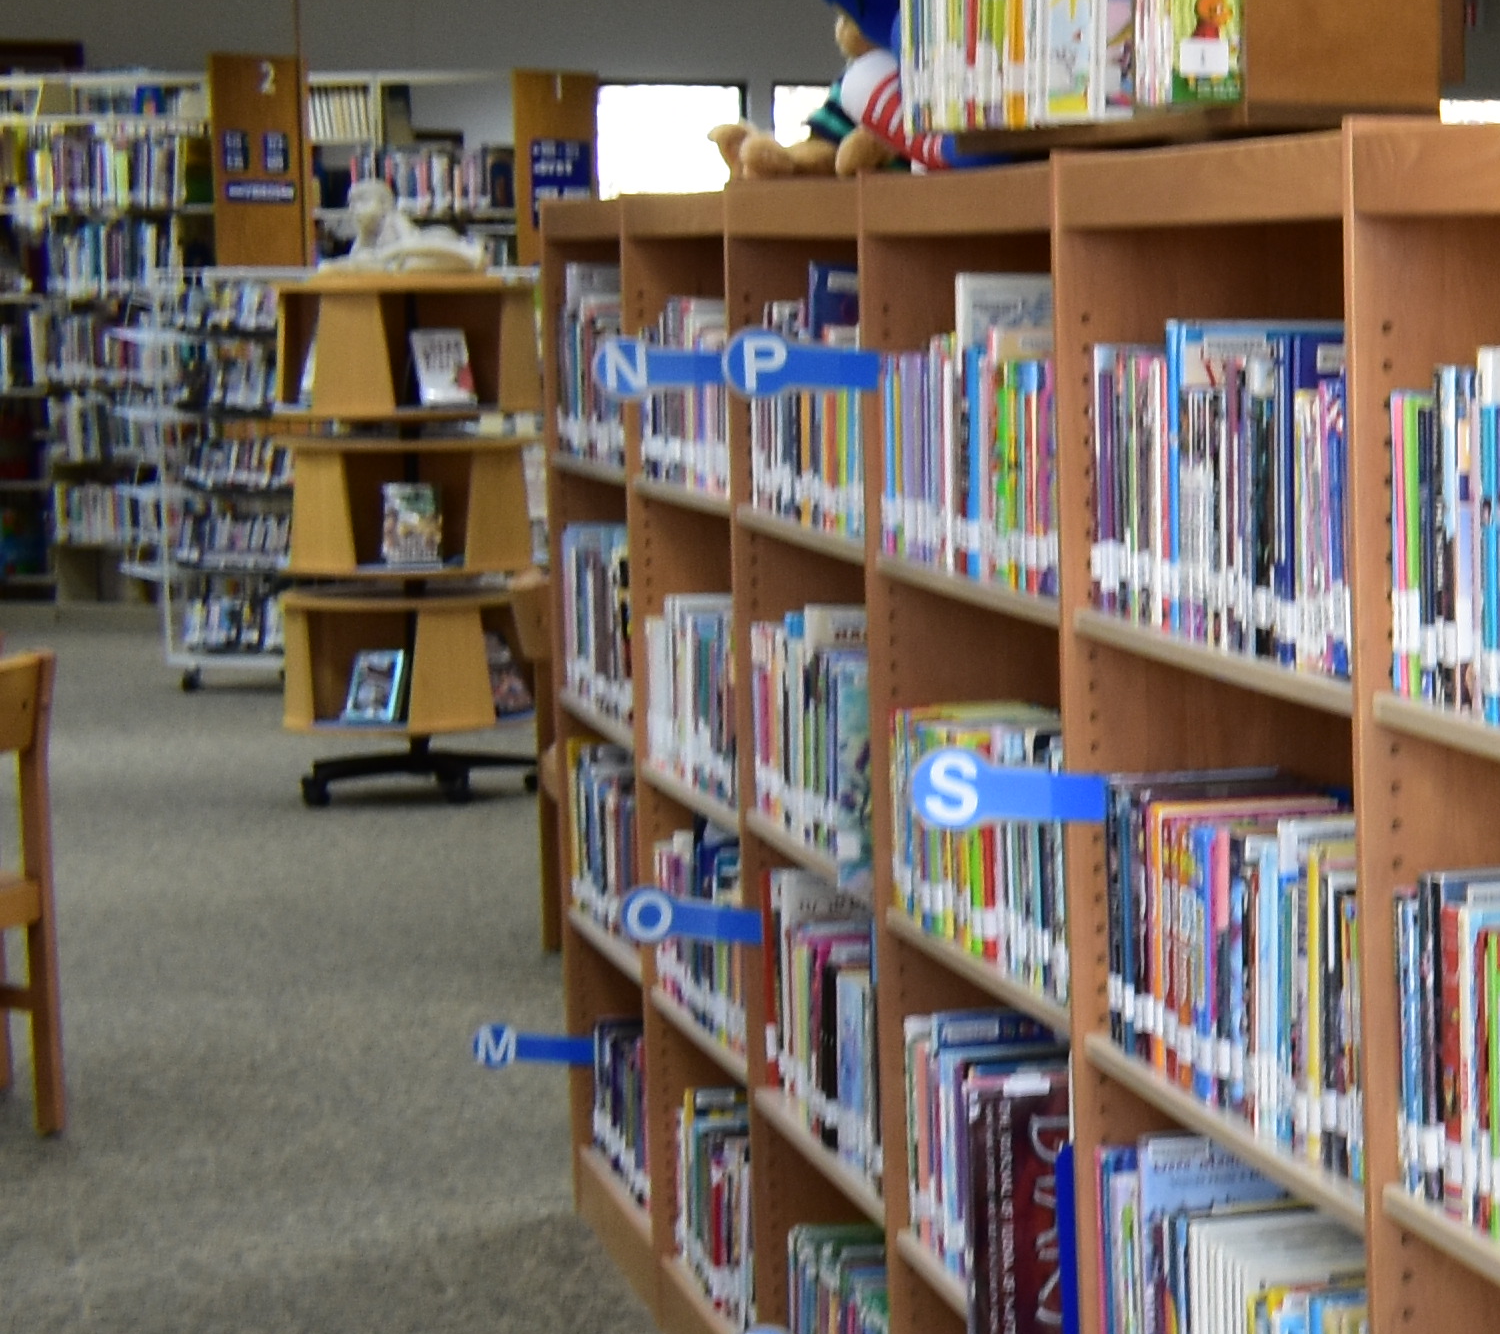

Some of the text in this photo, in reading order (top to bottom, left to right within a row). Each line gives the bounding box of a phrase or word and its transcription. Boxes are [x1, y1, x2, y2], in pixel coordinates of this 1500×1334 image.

[258, 59, 277, 96] 2
[604, 342, 648, 389] N
[743, 337, 787, 391] P
[924, 756, 980, 821] S
[626, 894, 672, 939] O
[475, 1028, 516, 1063] M
